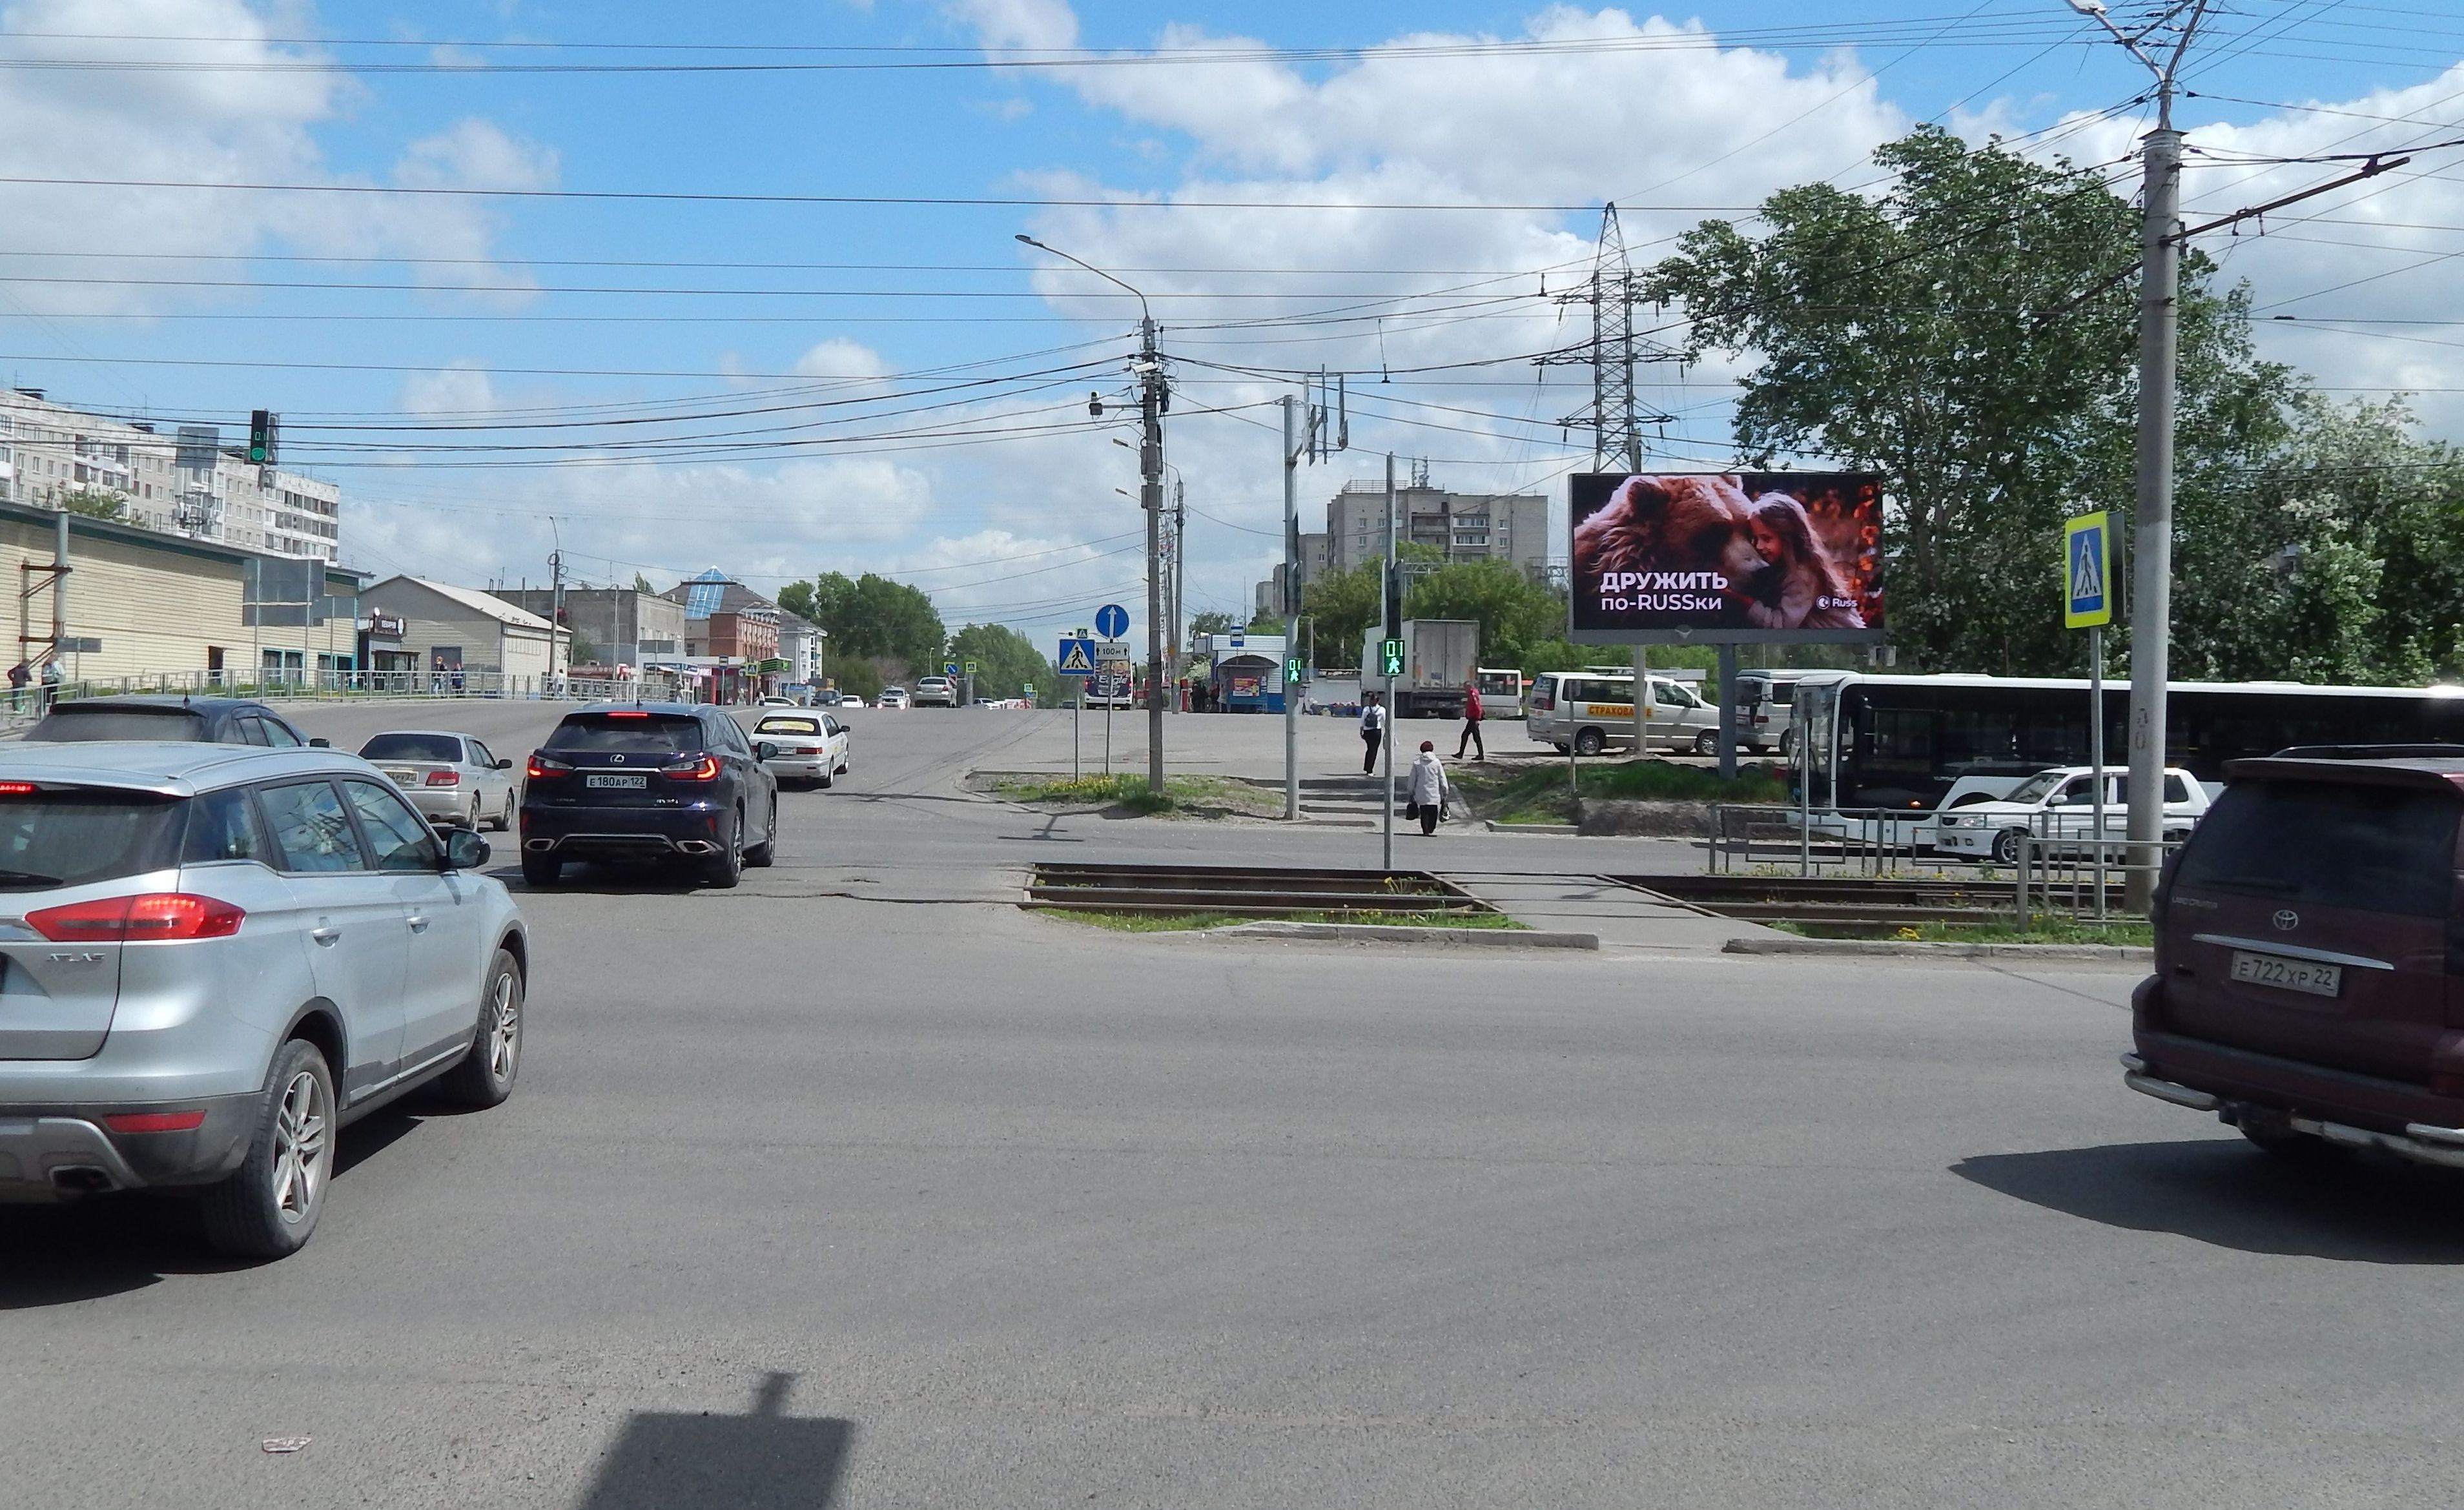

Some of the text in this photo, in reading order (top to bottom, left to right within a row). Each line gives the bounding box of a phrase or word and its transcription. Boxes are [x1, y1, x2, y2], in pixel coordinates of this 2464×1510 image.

[1600, 572, 1729, 593] ДРУЖИТЬ
[1601, 594, 1722, 610] по-RUSSки
[1832, 598, 1858, 607] Russ
[1386, 641, 1403, 657] 01
[1289, 659, 1301, 671] 01
[1589, 706, 1652, 717] СТРАХОВАЕ
[2314, 968, 2333, 986] 22
